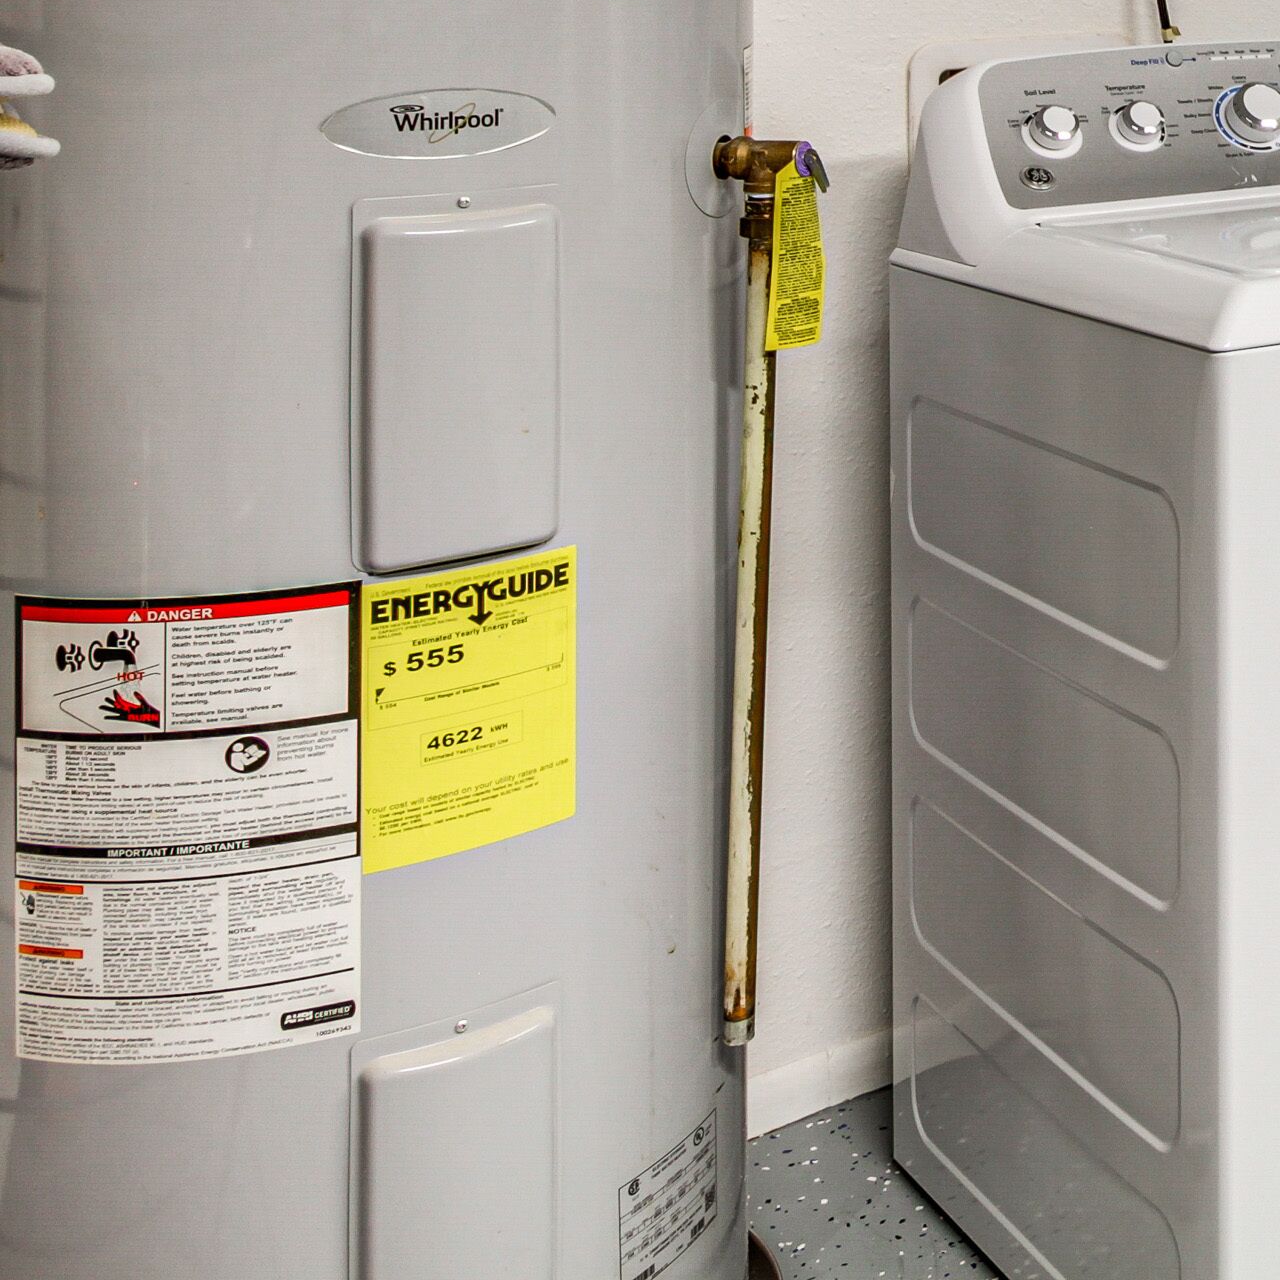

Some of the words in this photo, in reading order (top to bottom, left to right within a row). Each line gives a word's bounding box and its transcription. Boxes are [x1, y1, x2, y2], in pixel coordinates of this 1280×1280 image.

[1105, 84, 1145, 92] Temperature
[394, 109, 500, 134] Whirlpool
[371, 562, 569, 625] ENERGYGUIDE
[147, 608, 213, 621] DANGER
[412, 633, 452, 646] Estimated
[455, 628, 480, 638] Yearly
[483, 623, 509, 633] Energy
[512, 616, 528, 626] Cost
[180, 659, 206, 667] highest
[383, 661, 397, 677] $
[406, 644, 464, 672] 555
[116, 672, 145, 681] HOT
[226, 667, 253, 675] manual
[197, 677, 240, 685] temperature
[127, 713, 159, 721] BURN
[171, 710, 215, 718] Temperature
[427, 726, 483, 750] 4622
[490, 723, 508, 733] kWH
[366, 805, 387, 815] Your
[389, 800, 408, 811] cost
[410, 795, 424, 806] will
[427, 789, 459, 805] depend
[474, 781, 493, 792] your
[494, 774, 516, 786] utility
[518, 768, 537, 778] rates
[539, 762, 554, 772] and
[555, 758, 569, 767] use
[107, 848, 168, 857] IMPORTANT
[176, 840, 250, 855] IMPORTANTE
[228, 926, 256, 934] NOTICE
[314, 1006, 350, 1019] CERTIFIED
